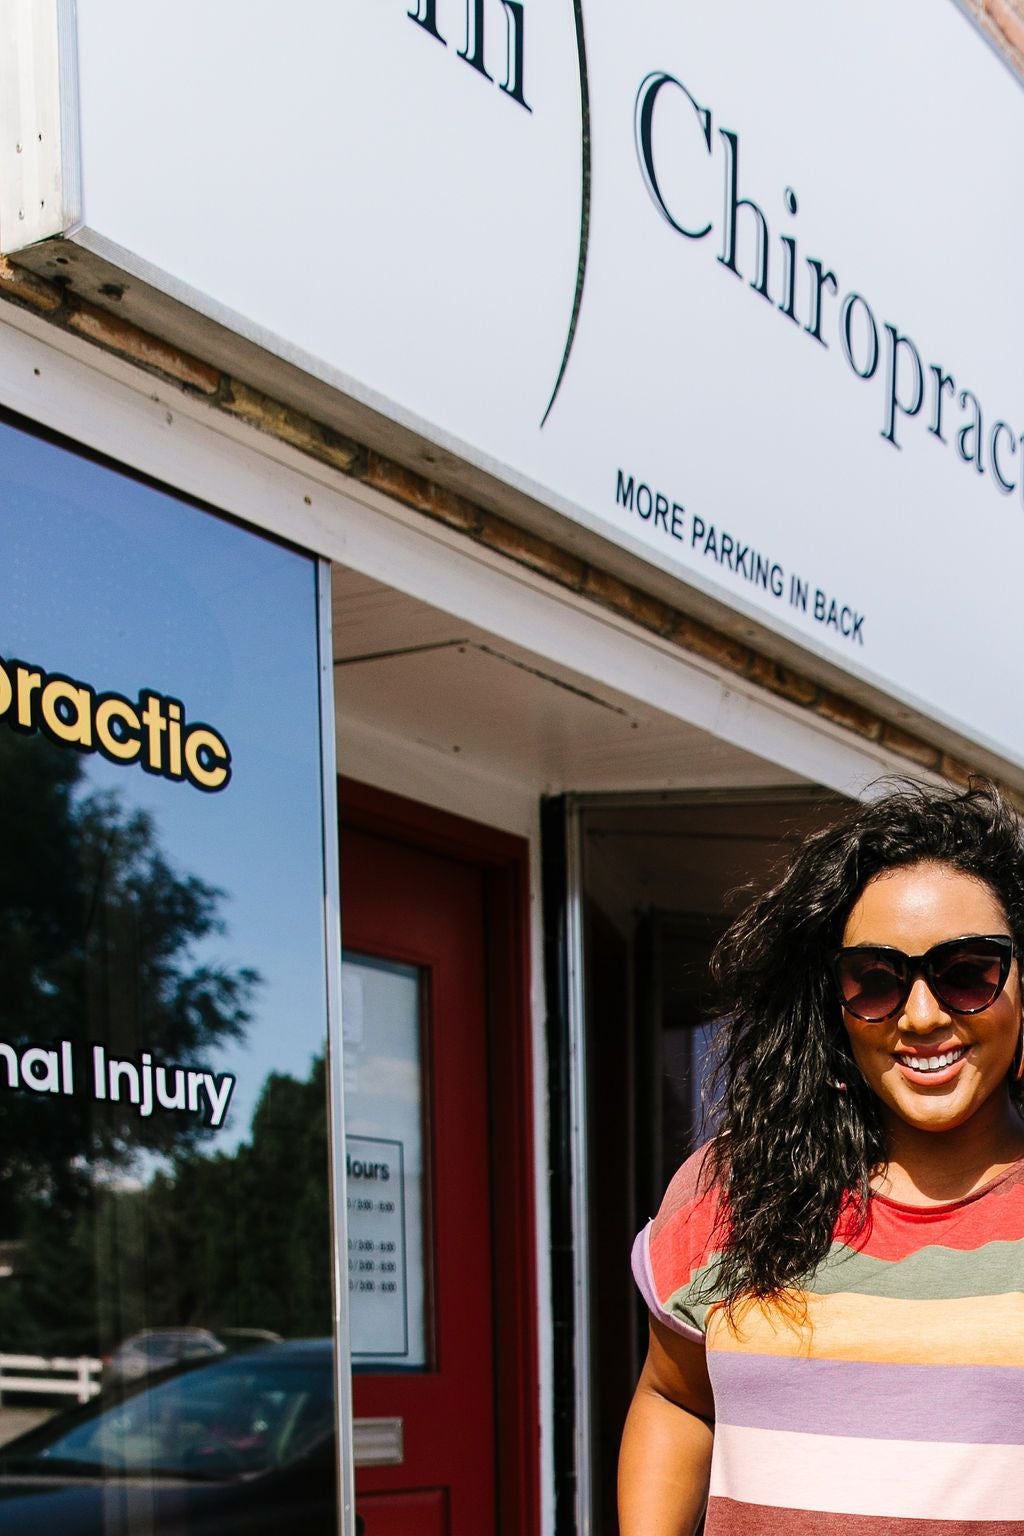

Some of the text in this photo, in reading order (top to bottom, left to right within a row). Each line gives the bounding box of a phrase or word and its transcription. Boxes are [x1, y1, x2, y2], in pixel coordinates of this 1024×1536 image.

[616, 469, 865, 646] MORE PARKING IN BACK
[0, 657, 231, 791] ractic
[93, 1046, 234, 1126] Injury
